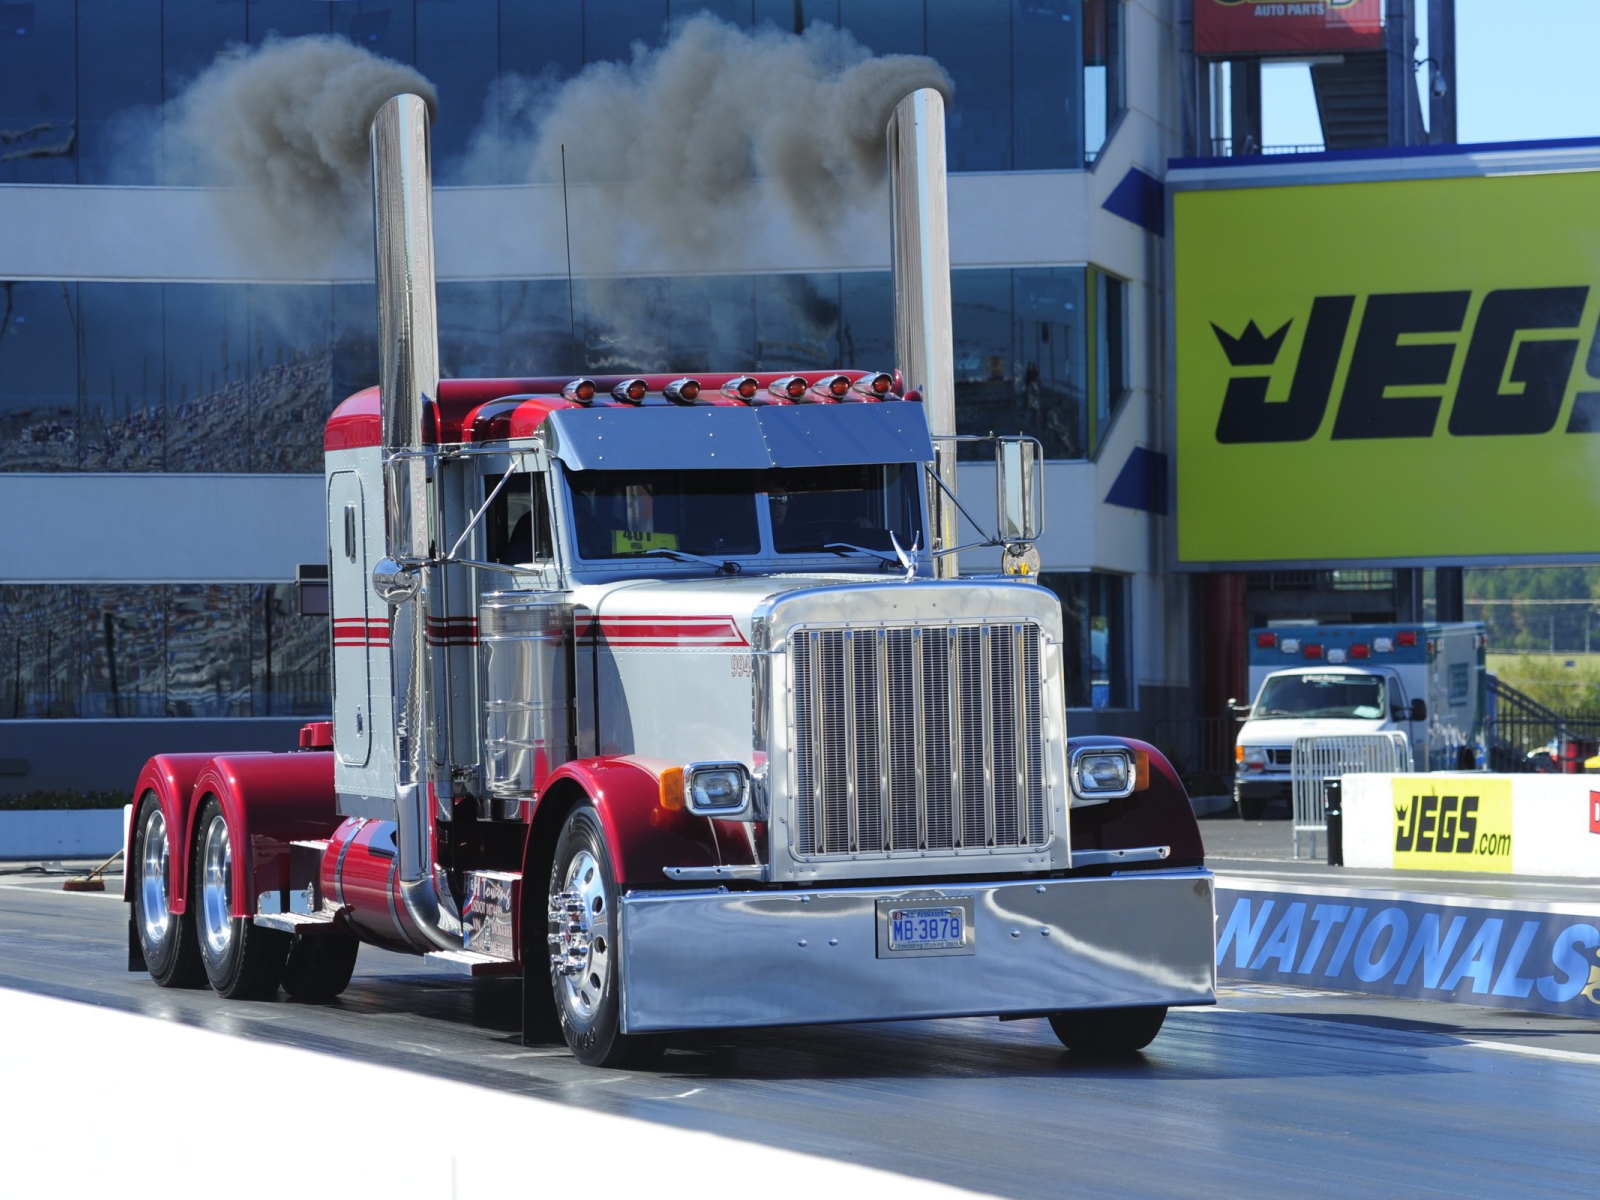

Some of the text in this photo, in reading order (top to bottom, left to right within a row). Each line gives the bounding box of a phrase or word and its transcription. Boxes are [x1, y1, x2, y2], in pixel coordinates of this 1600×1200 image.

[1254, 4, 1284, 17] AUTO
[1287, 3, 1325, 16] PARTS
[481, 877, 512, 910] Towing
[1216, 897, 1600, 1003] NATIONALS
